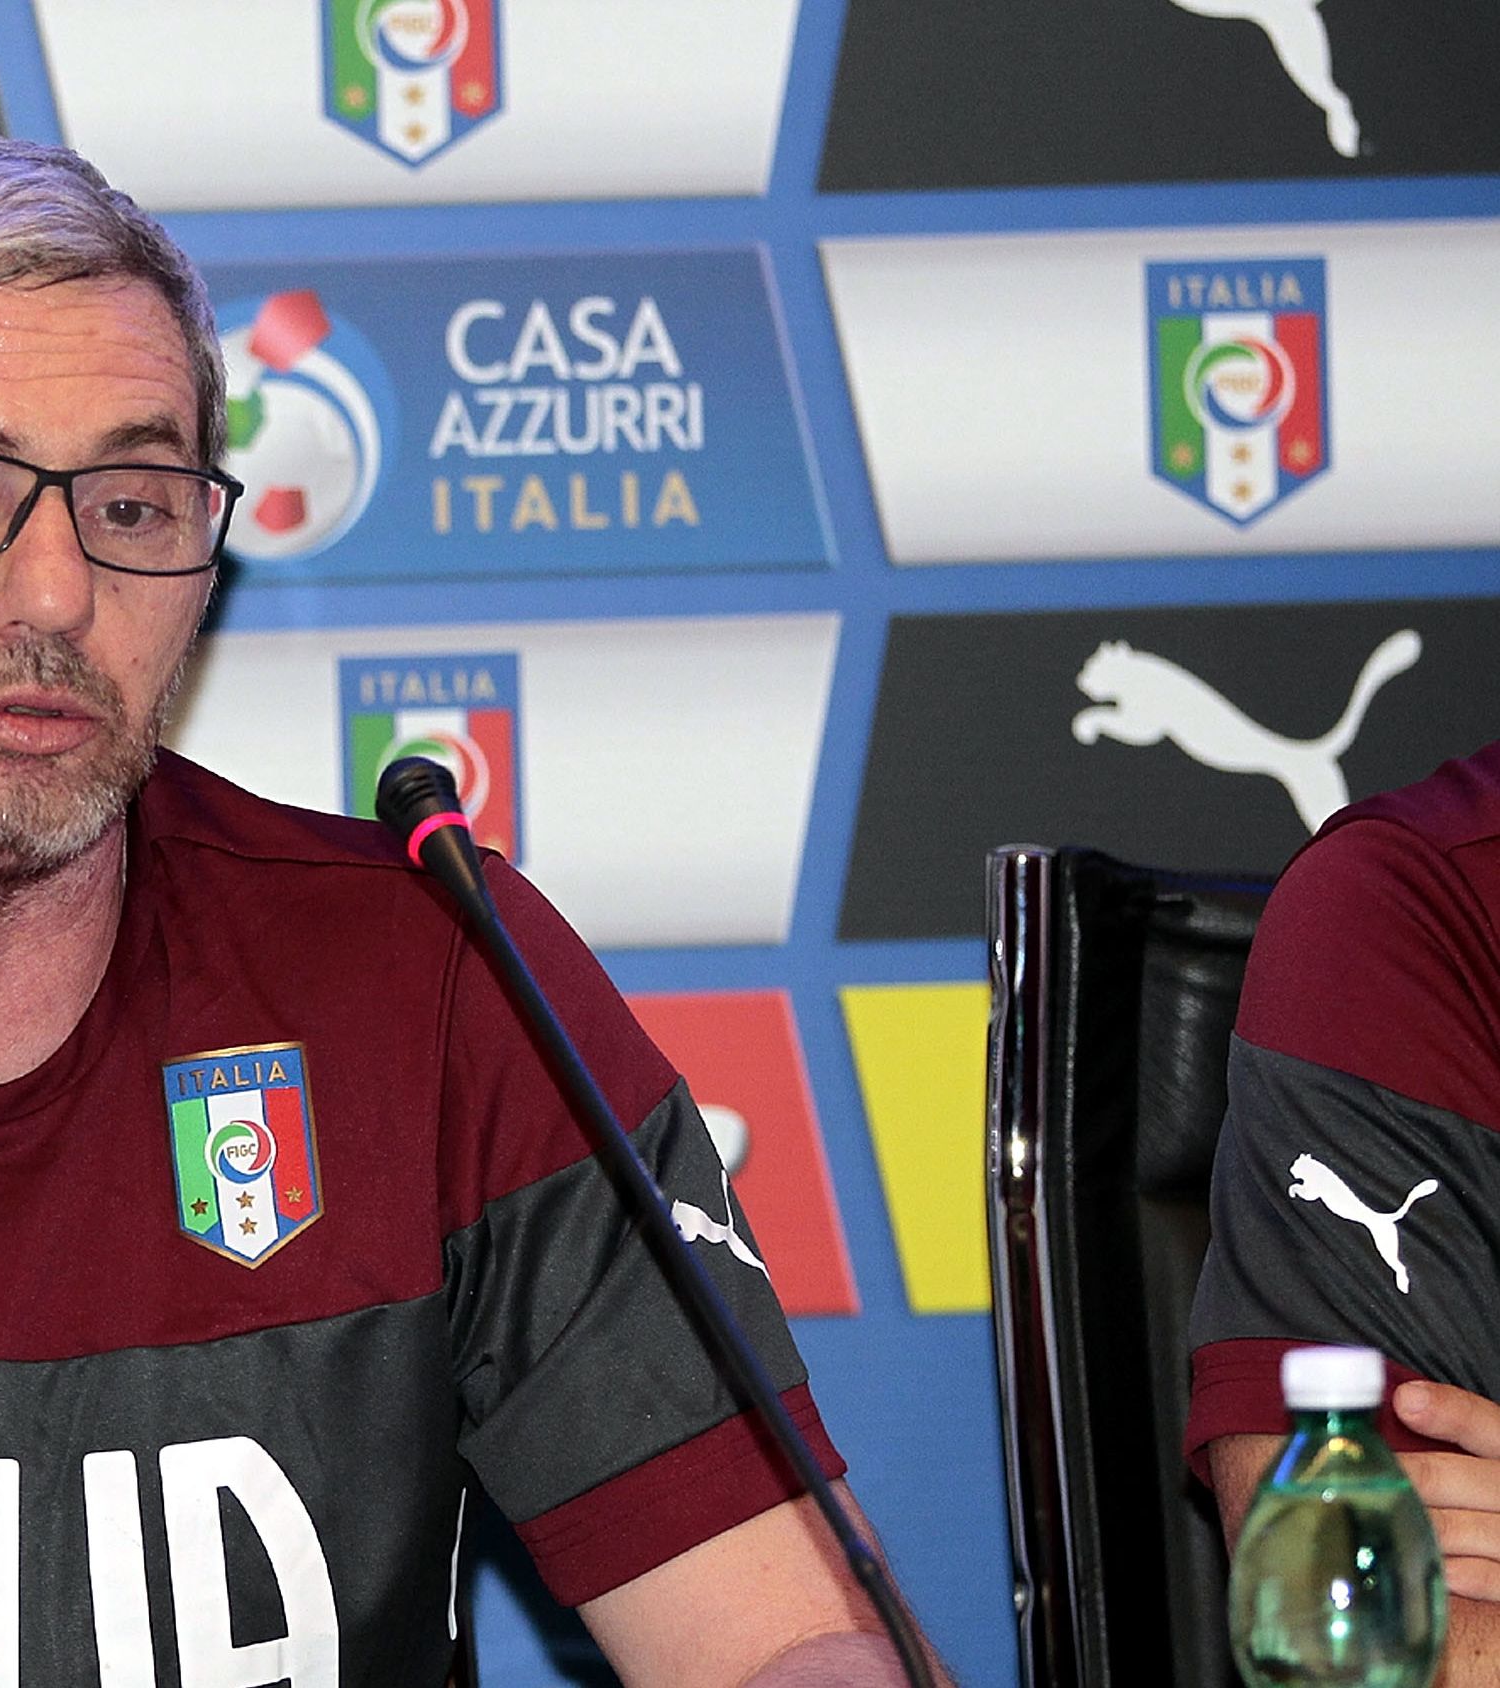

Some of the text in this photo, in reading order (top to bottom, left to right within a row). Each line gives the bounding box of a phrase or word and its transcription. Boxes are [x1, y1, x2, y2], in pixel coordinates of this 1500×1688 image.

[1167, 271, 1303, 309] ITALIA
[444, 298, 683, 384] CASA
[429, 383, 704, 458] AZZURRI
[431, 471, 700, 535] ITALIA
[360, 668, 496, 705] ITALIA
[178, 1060, 288, 1095] ITALIA
[227, 1143, 257, 1158] FIGC
